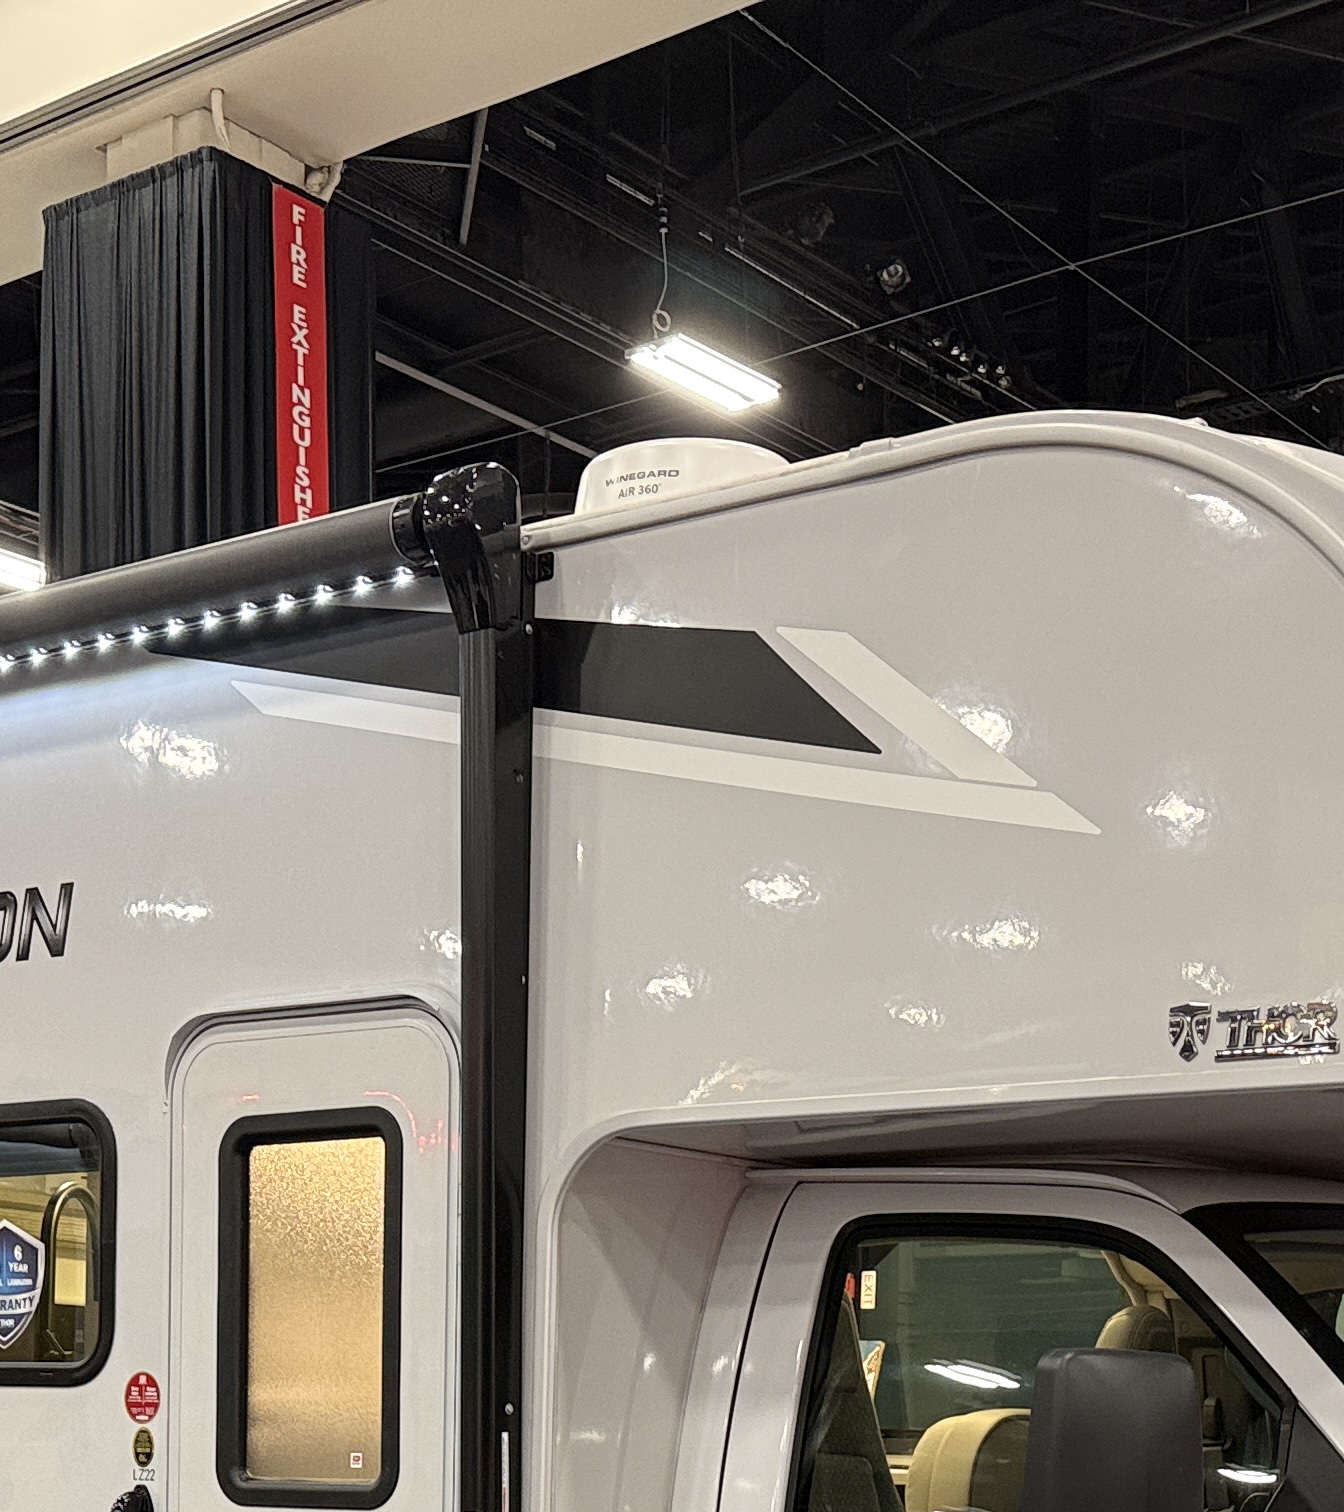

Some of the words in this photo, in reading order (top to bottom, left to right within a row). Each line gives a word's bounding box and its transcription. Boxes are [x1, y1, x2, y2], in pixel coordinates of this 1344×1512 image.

[291, 203, 308, 289] FIRE
[605, 469, 680, 487] WINEGARD
[617, 486, 636, 500] AIR
[1216, 1000, 1340, 1048] THOR
[13, 1244, 23, 1262] 6
[8, 1261, 29, 1274] YEAR
[863, 1274, 874, 1306] EXIT
